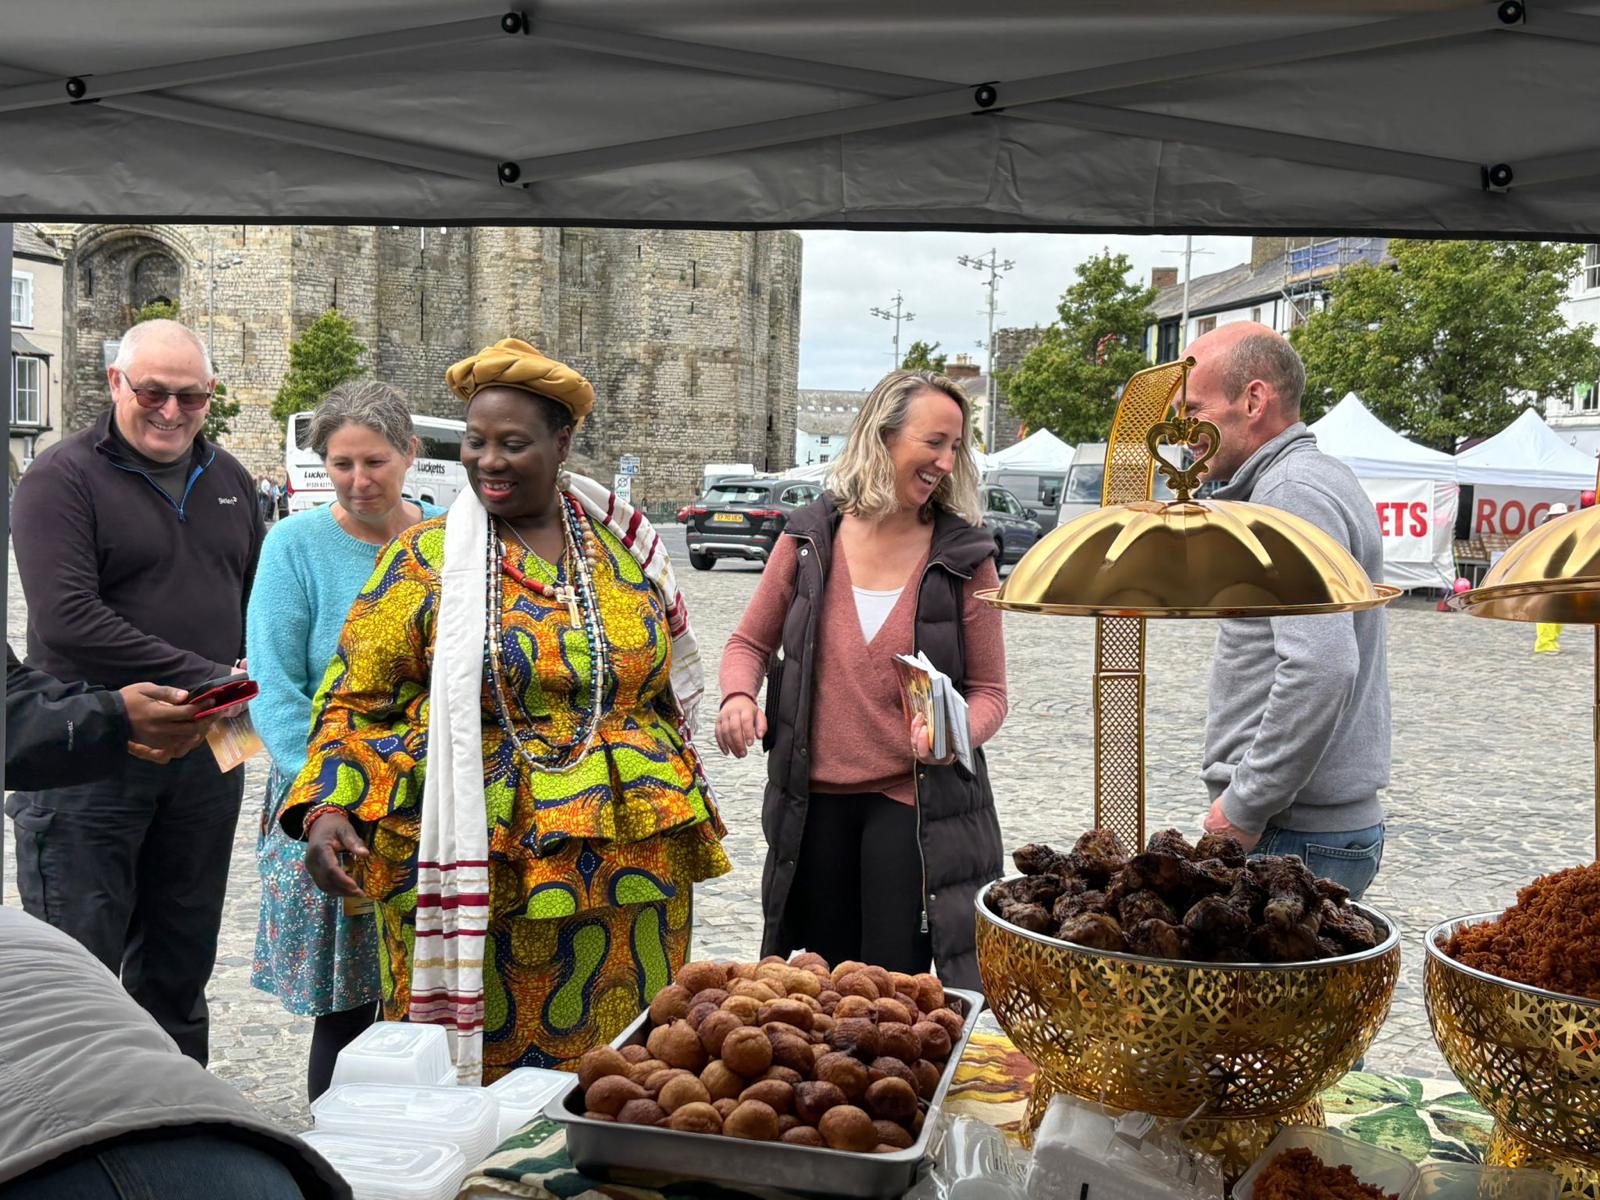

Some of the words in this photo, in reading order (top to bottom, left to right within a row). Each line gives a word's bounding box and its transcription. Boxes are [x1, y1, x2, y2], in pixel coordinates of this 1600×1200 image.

[304, 471, 329, 479] Lucket
[417, 461, 446, 475] Lucketts
[1376, 502, 1428, 537] ETS
[1475, 499, 1575, 536] ROC
